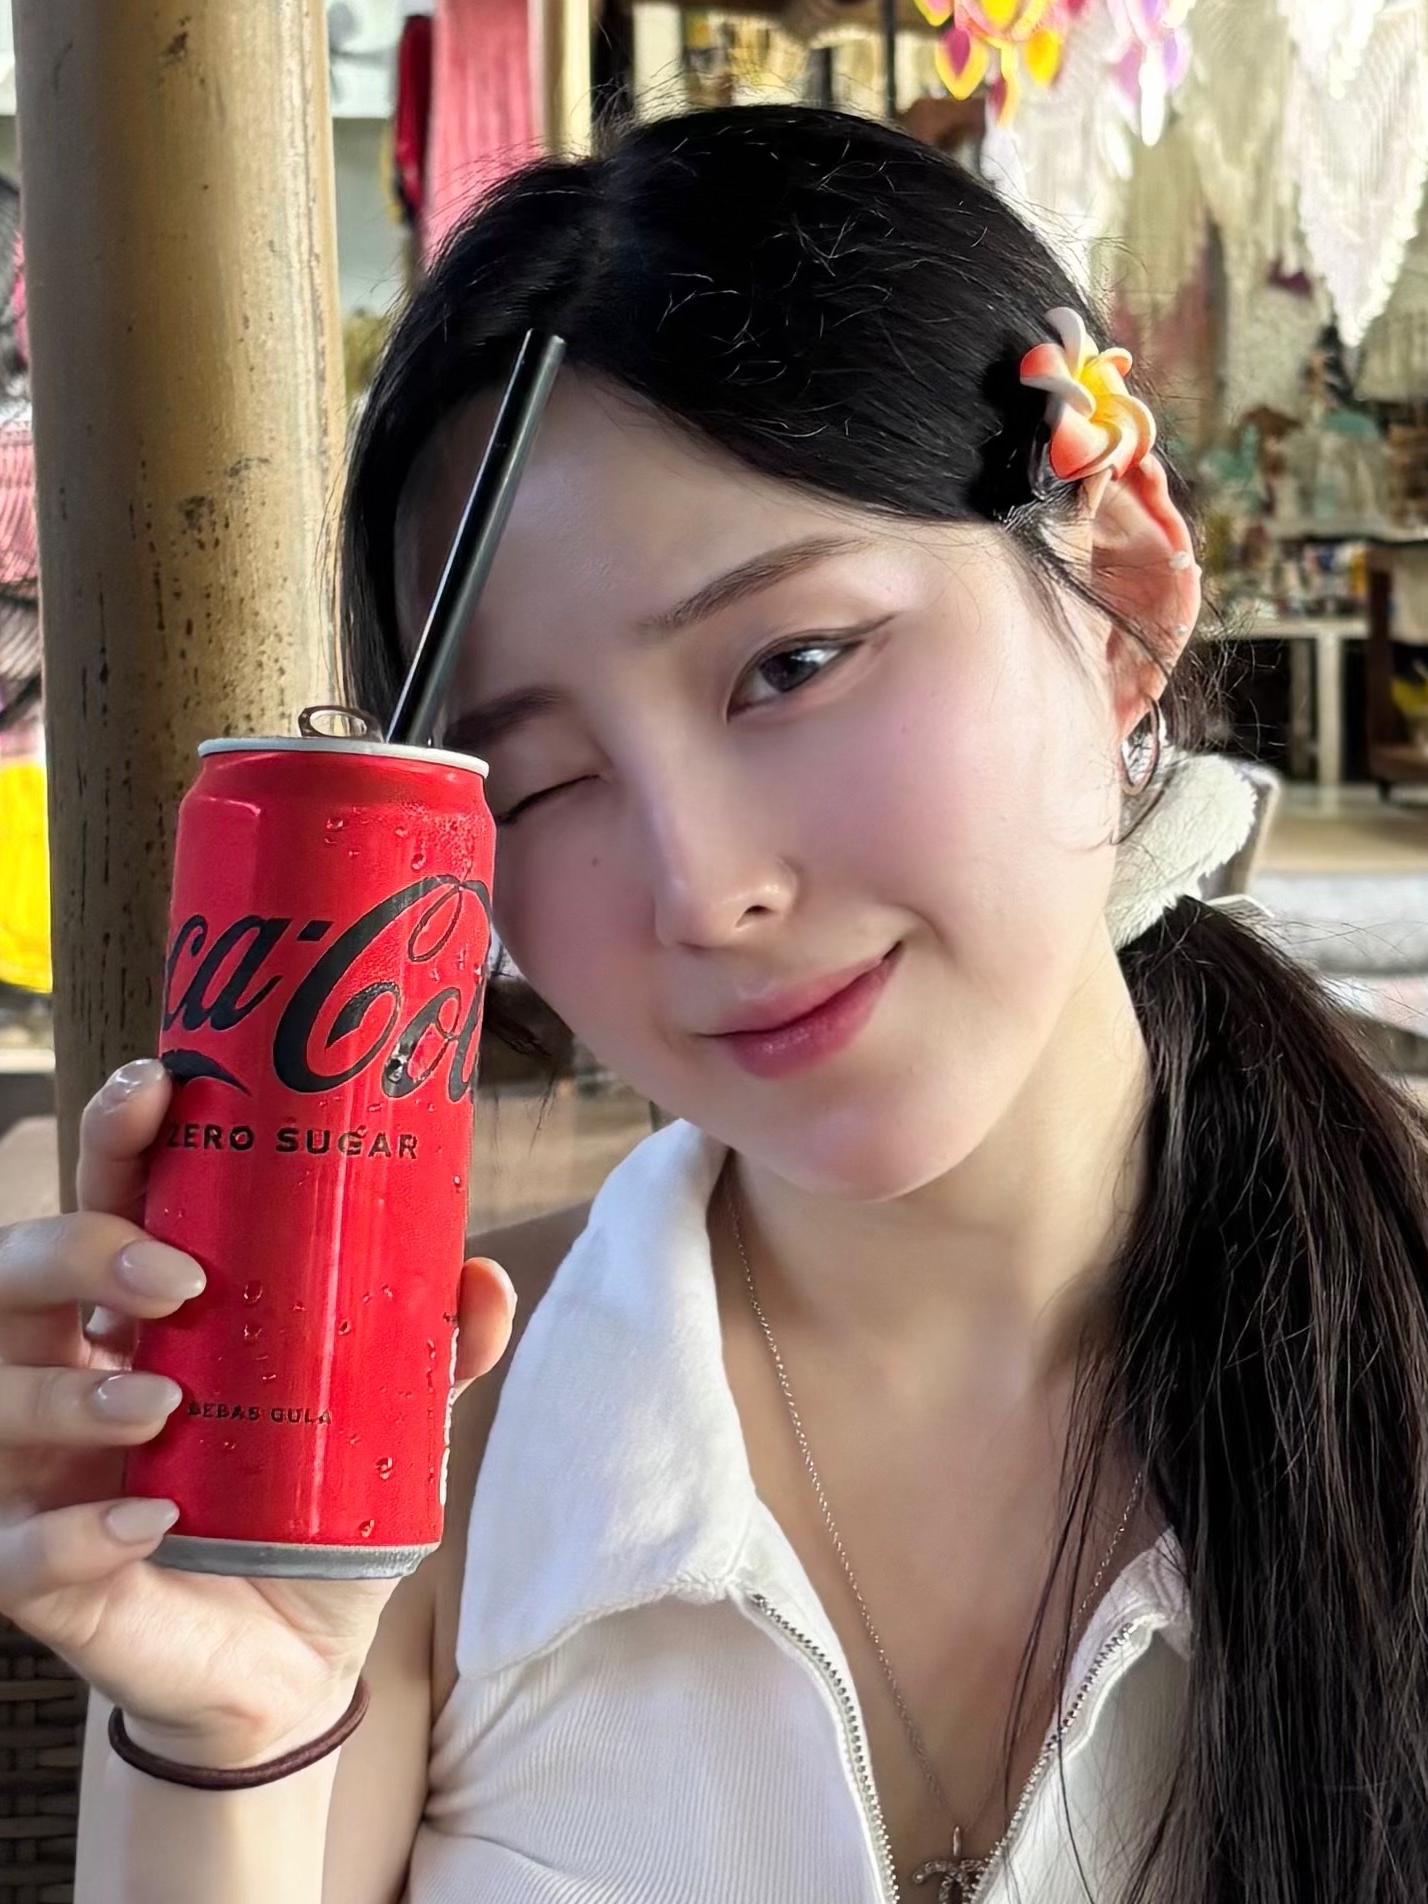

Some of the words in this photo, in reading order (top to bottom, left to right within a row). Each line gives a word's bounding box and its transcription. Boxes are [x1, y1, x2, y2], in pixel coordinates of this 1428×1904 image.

[167, 1122, 255, 1151] ZERO
[275, 1126, 418, 1160] SUGAR
[271, 1407, 332, 1425] GULA
